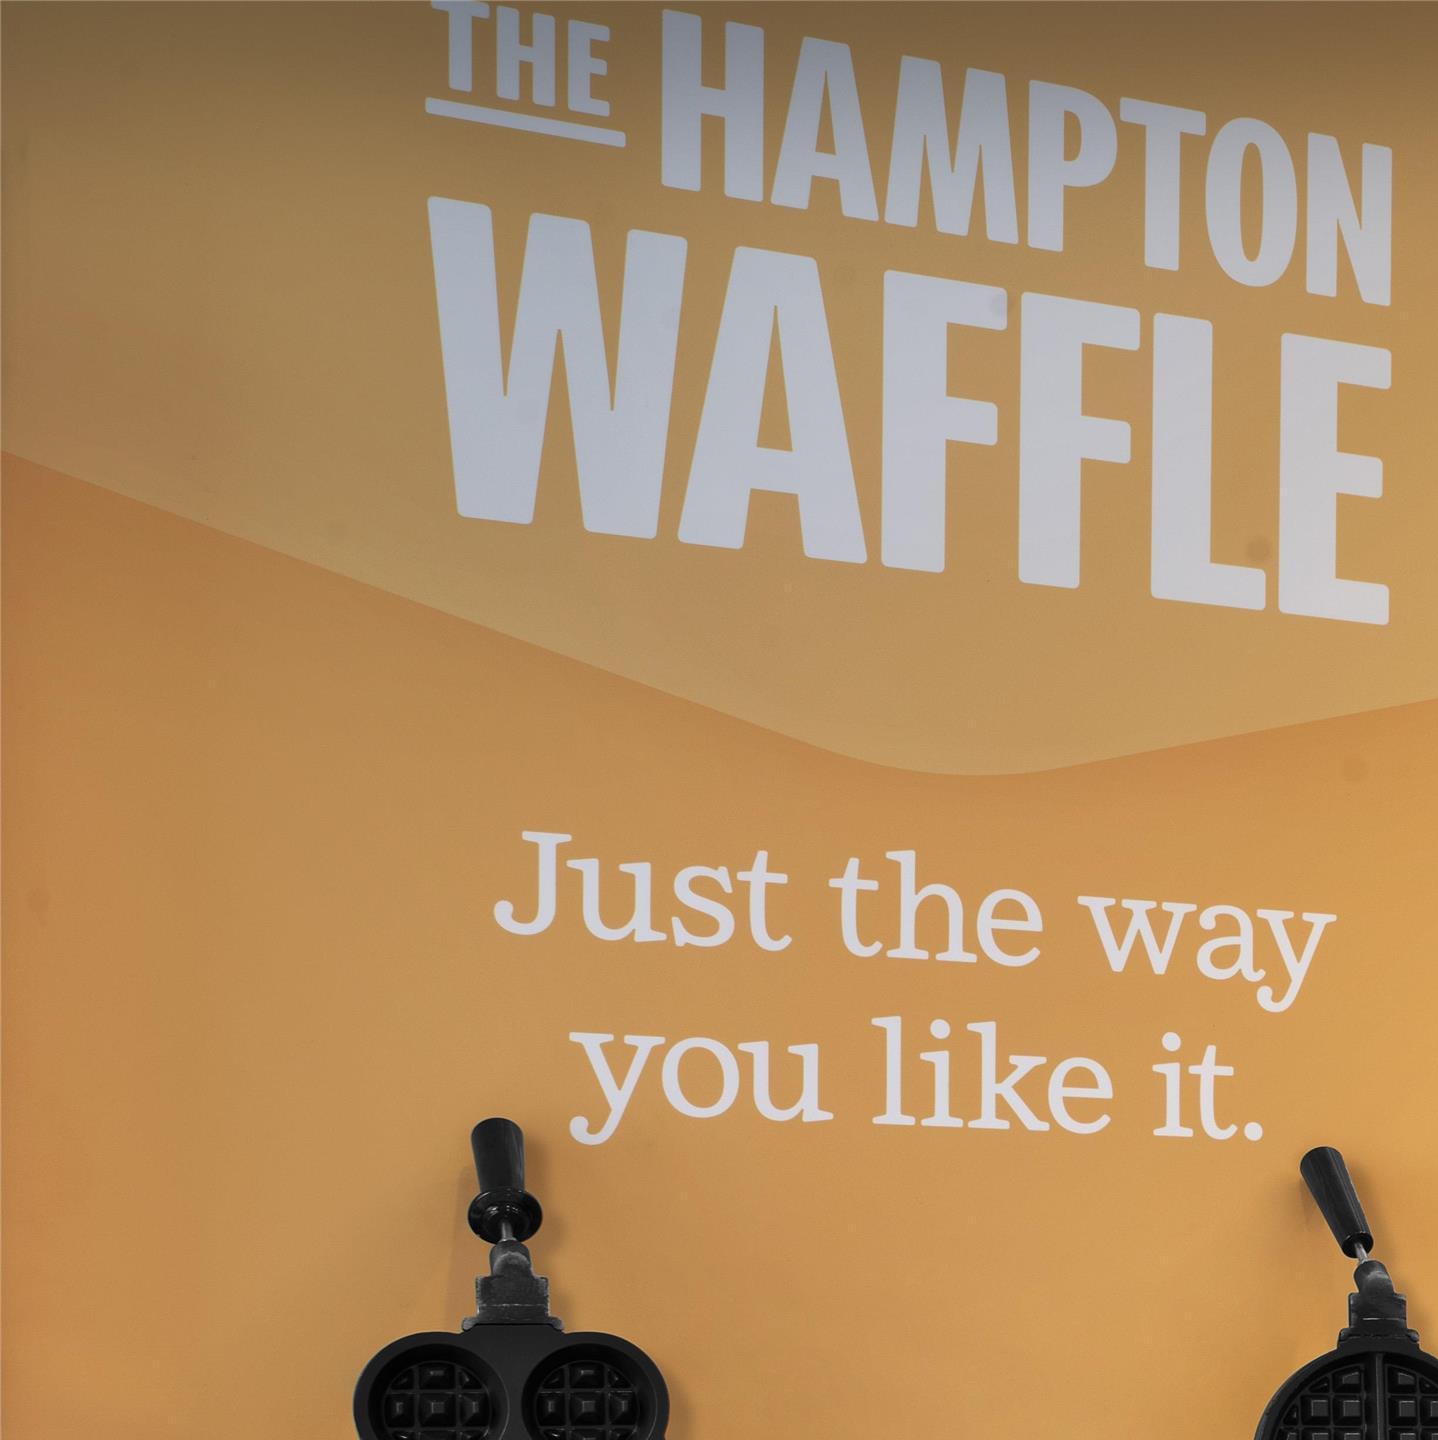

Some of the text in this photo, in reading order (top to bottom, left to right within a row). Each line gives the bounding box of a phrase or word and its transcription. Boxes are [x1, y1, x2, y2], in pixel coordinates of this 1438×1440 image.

[430, 0, 1393, 307] THE HAMPTON
[427, 195, 1393, 626] WAFFLE
[493, 830, 1338, 1013] Just the way
[569, 1015, 1264, 1146] you like it.
